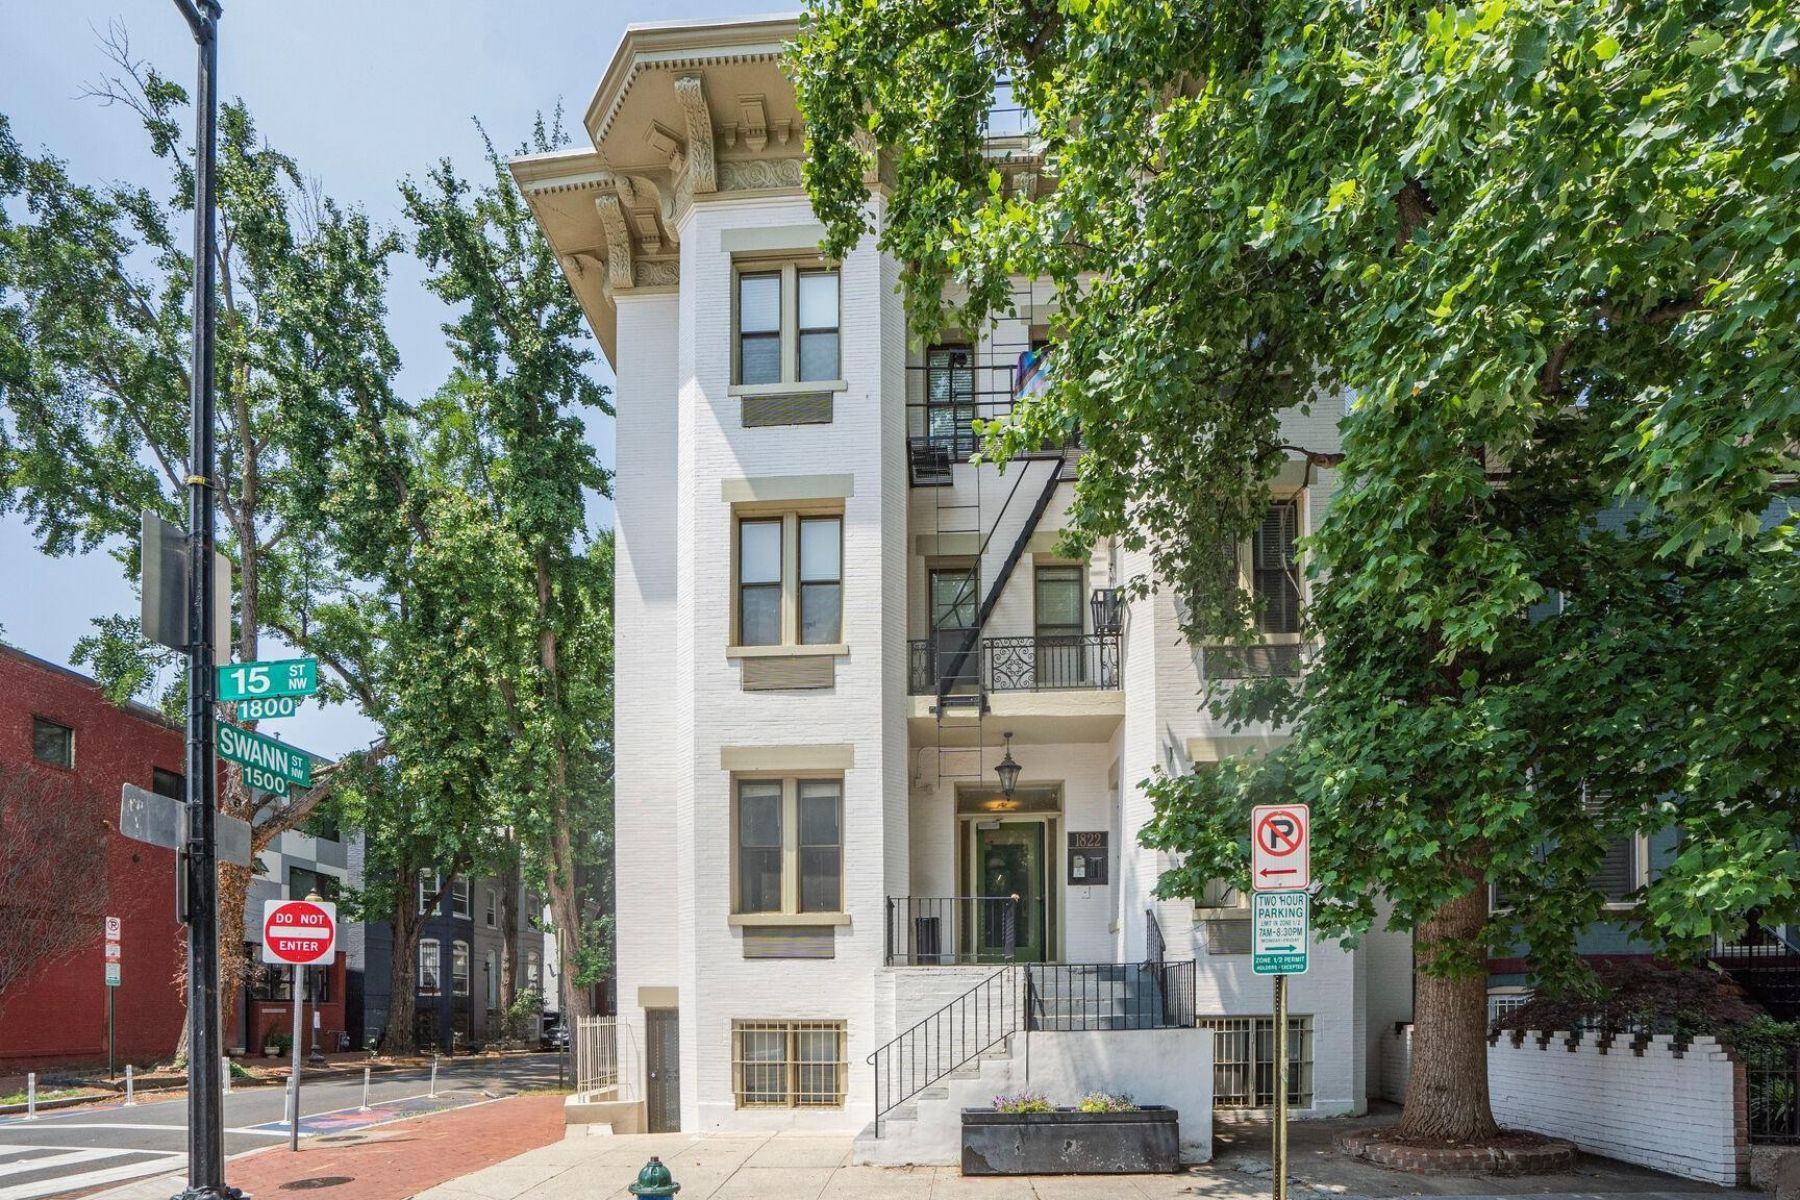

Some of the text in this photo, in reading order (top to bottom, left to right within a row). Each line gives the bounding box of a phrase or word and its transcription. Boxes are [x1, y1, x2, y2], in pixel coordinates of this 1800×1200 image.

[231, 664, 305, 694] 15 ST
[289, 678, 307, 690] NW
[240, 697, 293, 718] 1800
[220, 727, 303, 775] SWANN ST
[245, 767, 285, 794] 1500
[292, 768, 304, 780] NW
[1077, 833, 1101, 847] 1822
[1271, 819, 1294, 848] P
[1259, 895, 1304, 906] TWO HOUR
[276, 913, 324, 924] DO NOT
[1259, 907, 1303, 918] PARKING
[279, 940, 319, 951] ENTER
